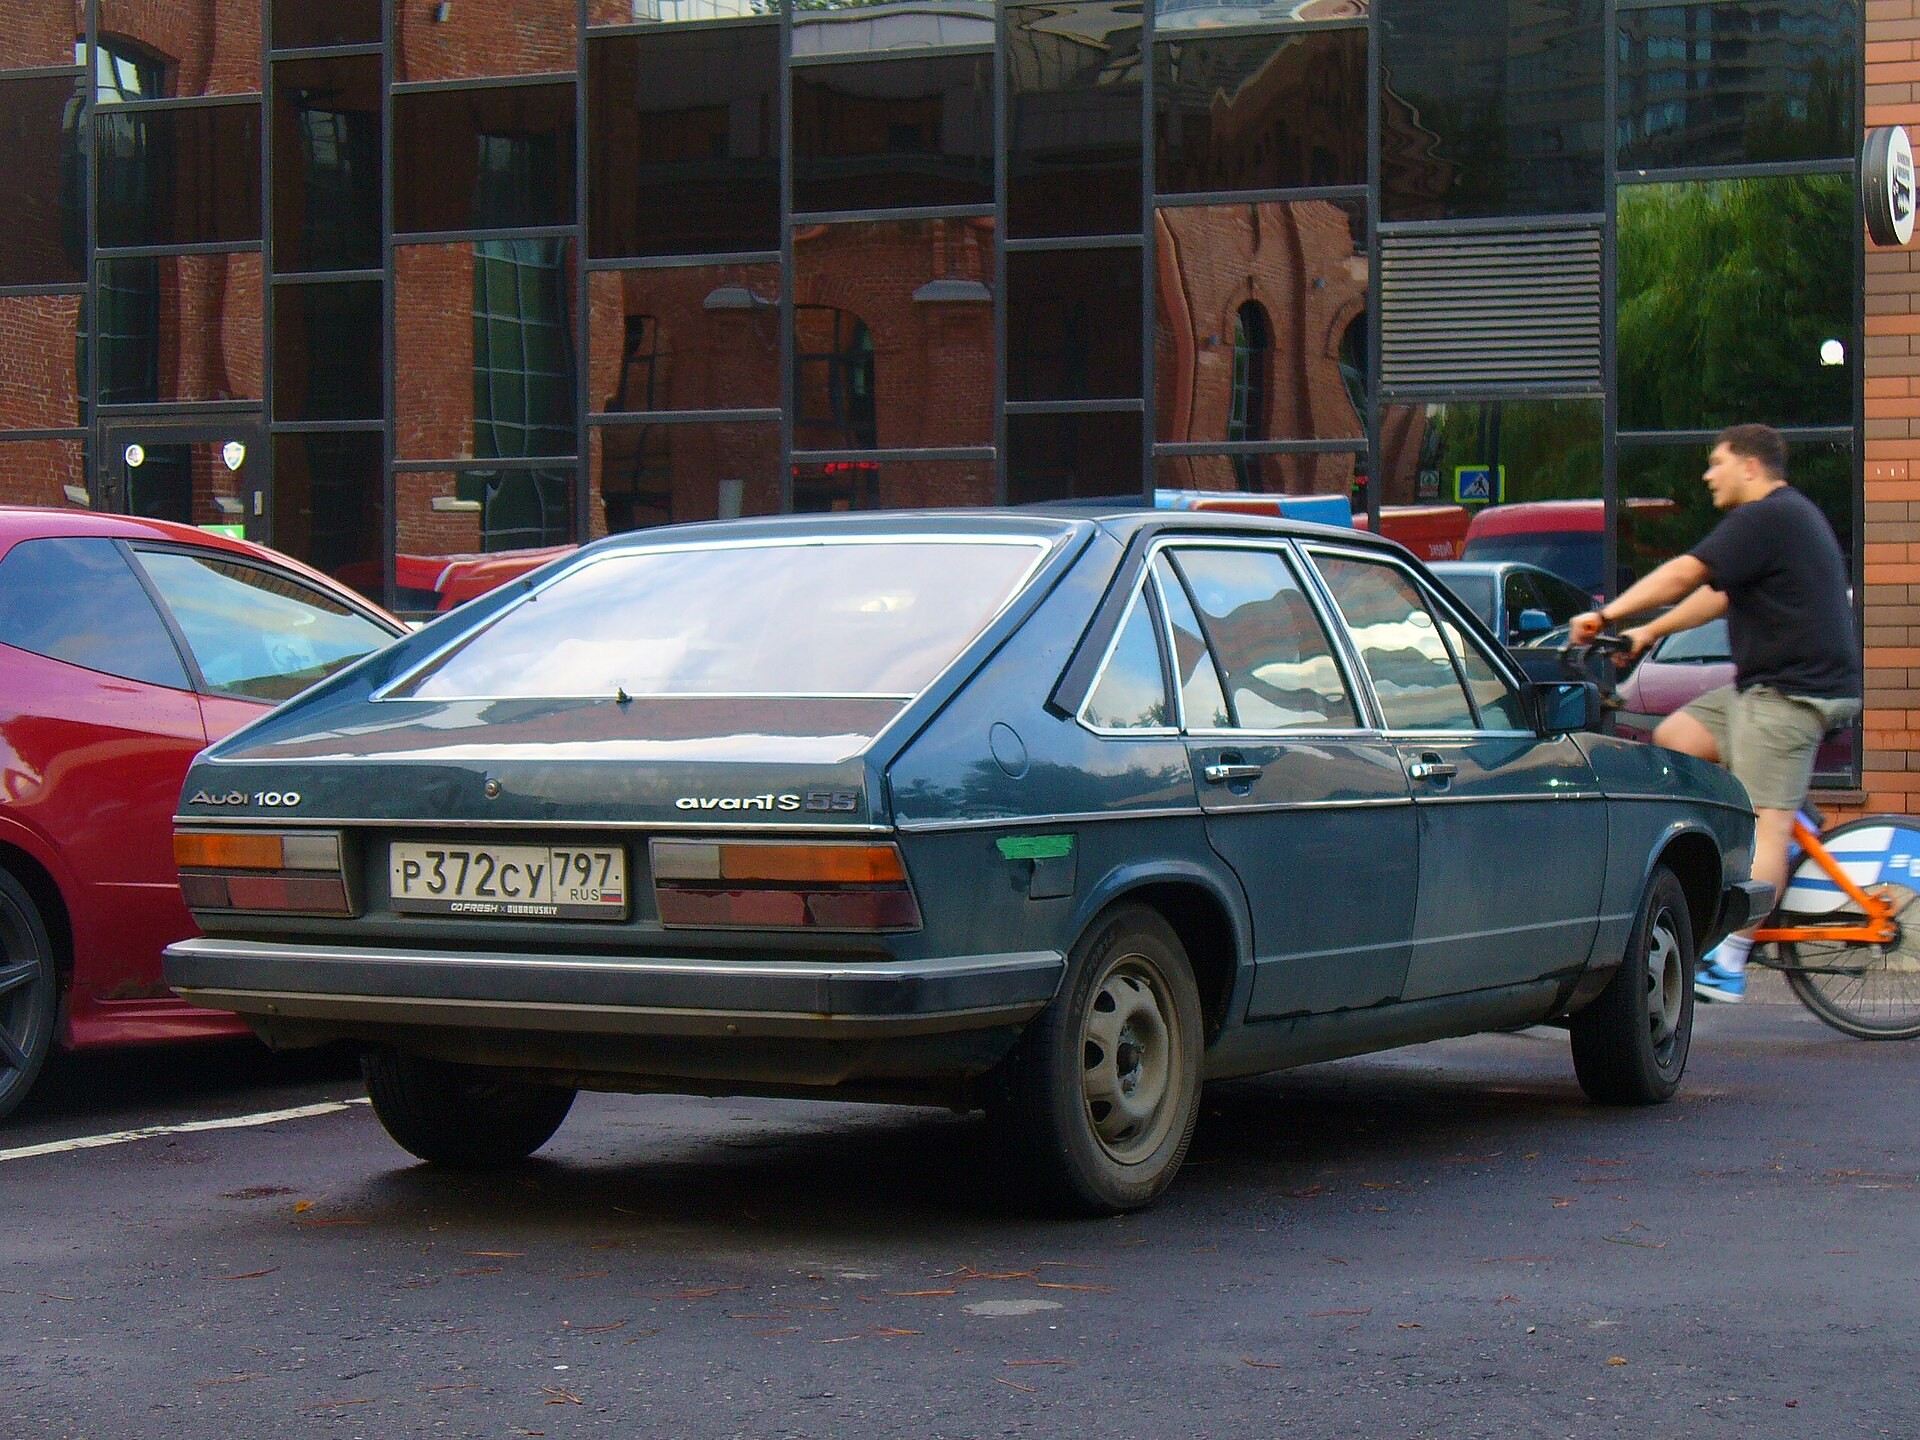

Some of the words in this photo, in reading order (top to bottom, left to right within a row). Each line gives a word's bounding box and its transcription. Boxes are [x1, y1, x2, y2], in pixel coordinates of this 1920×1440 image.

[188, 790, 249, 806] Audi
[254, 790, 301, 807] 100
[805, 790, 859, 813] 5S
[553, 851, 611, 887] 797
[569, 887, 599, 901] RUS
